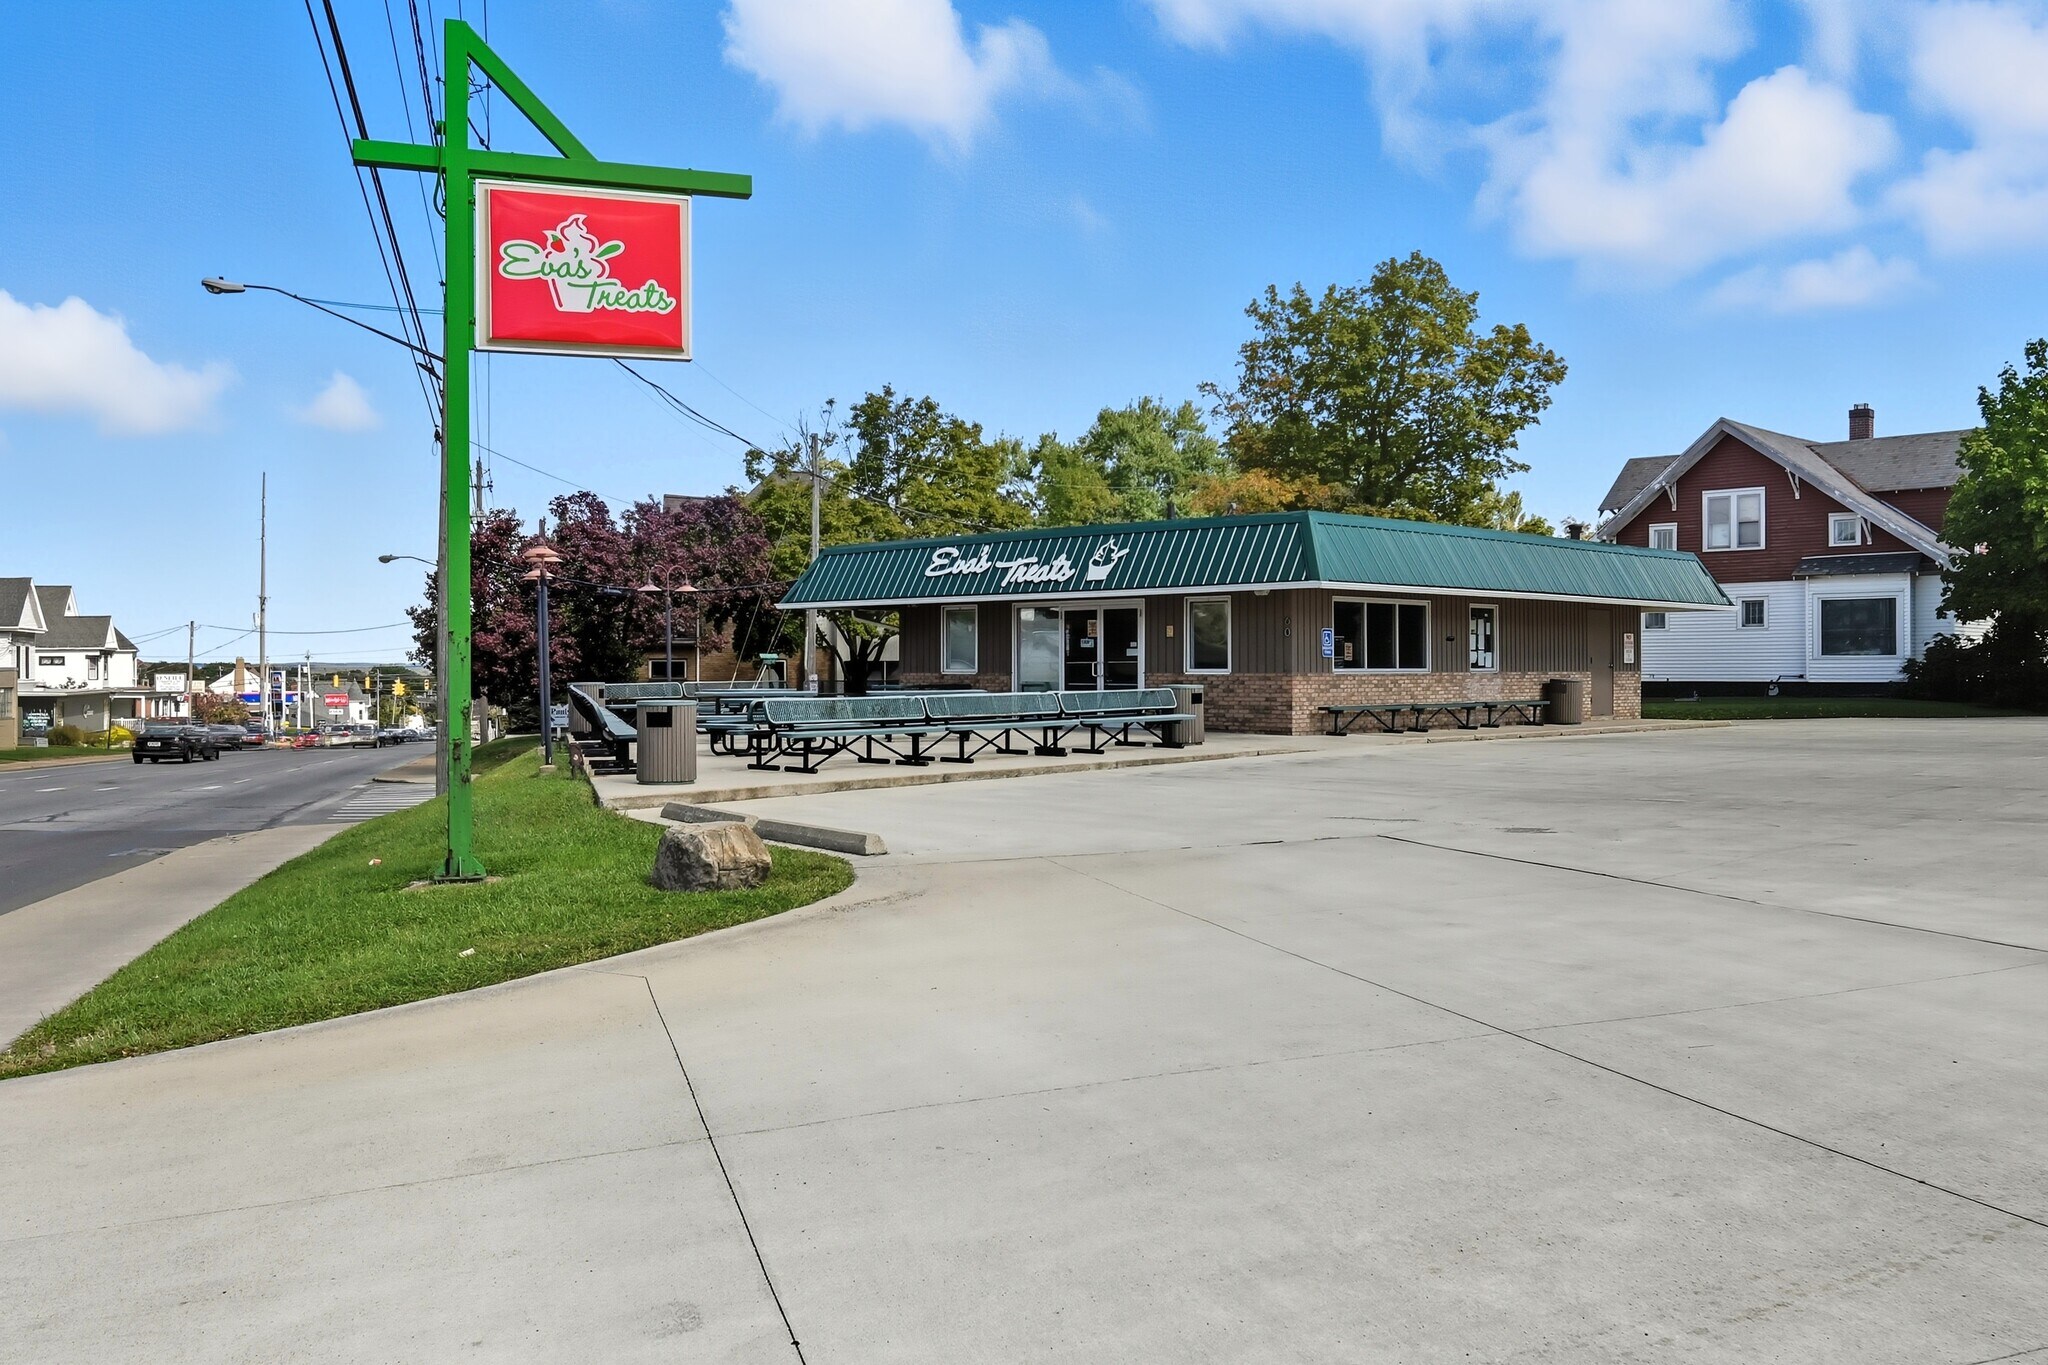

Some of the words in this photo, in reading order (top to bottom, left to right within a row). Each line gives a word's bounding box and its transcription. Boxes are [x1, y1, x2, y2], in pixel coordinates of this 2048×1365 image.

[502, 243, 592, 279] Eva's
[567, 281, 673, 311] Treats
[925, 545, 992, 577] Eva's
[996, 553, 1075, 587] Treats
